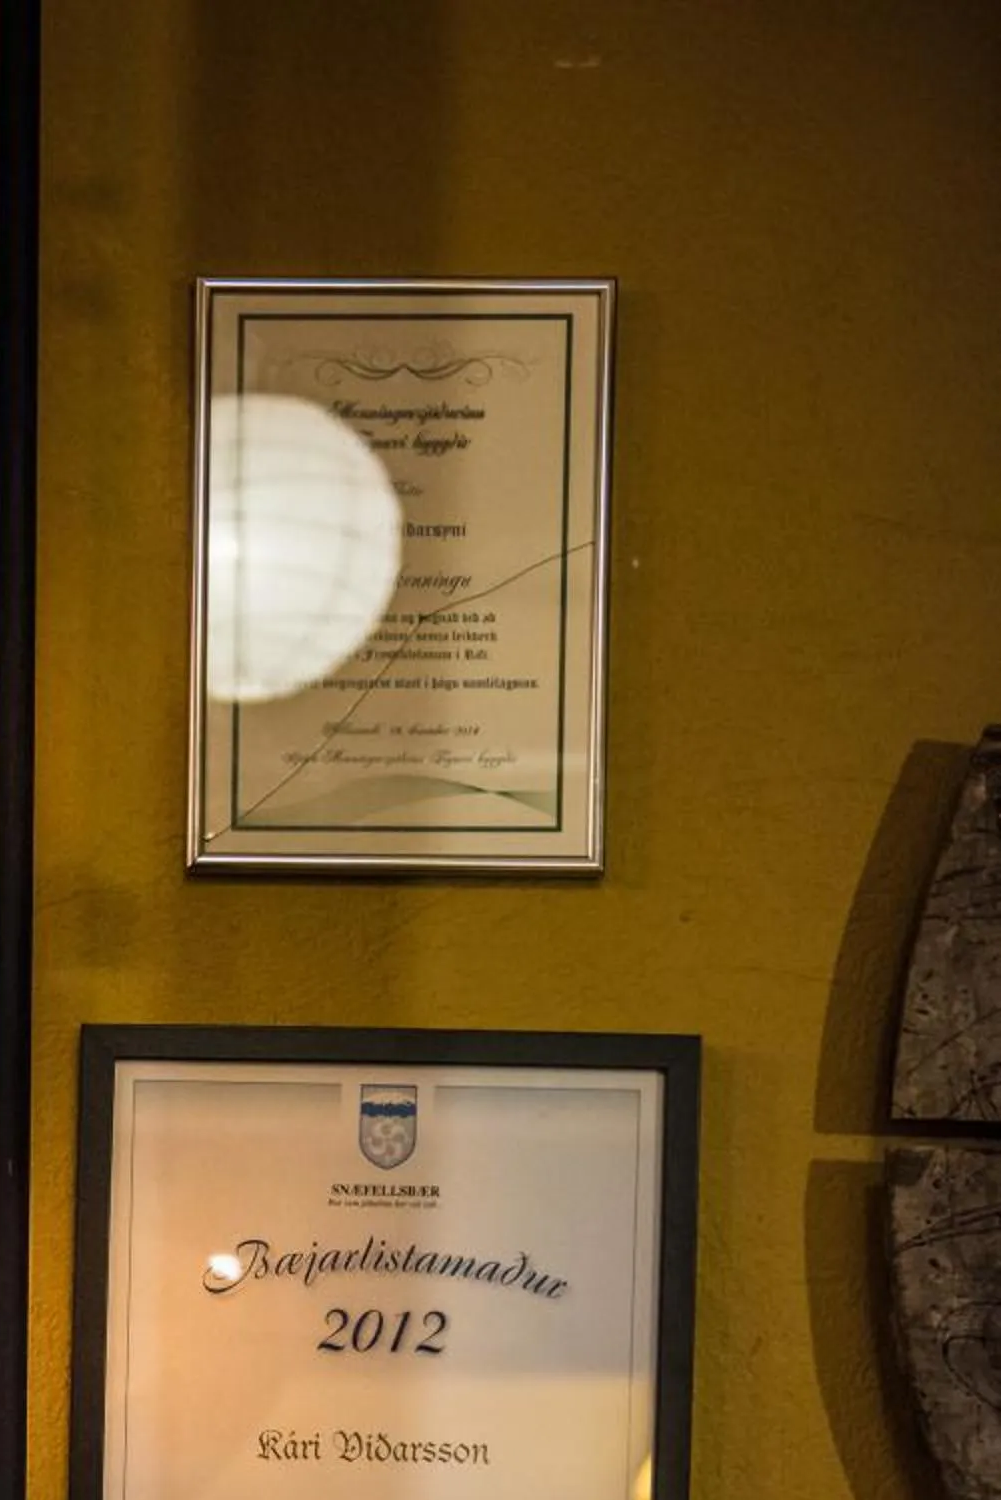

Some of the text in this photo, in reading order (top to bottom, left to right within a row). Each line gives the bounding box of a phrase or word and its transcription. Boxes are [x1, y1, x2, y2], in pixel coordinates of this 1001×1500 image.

[330, 1183, 440, 1198] SNÆFELLSBÆR
[202, 1235, 568, 1300] Bæjarlistamaður
[317, 1308, 449, 1354] 2012
[257, 1429, 490, 1465] Kári Viðarsson
